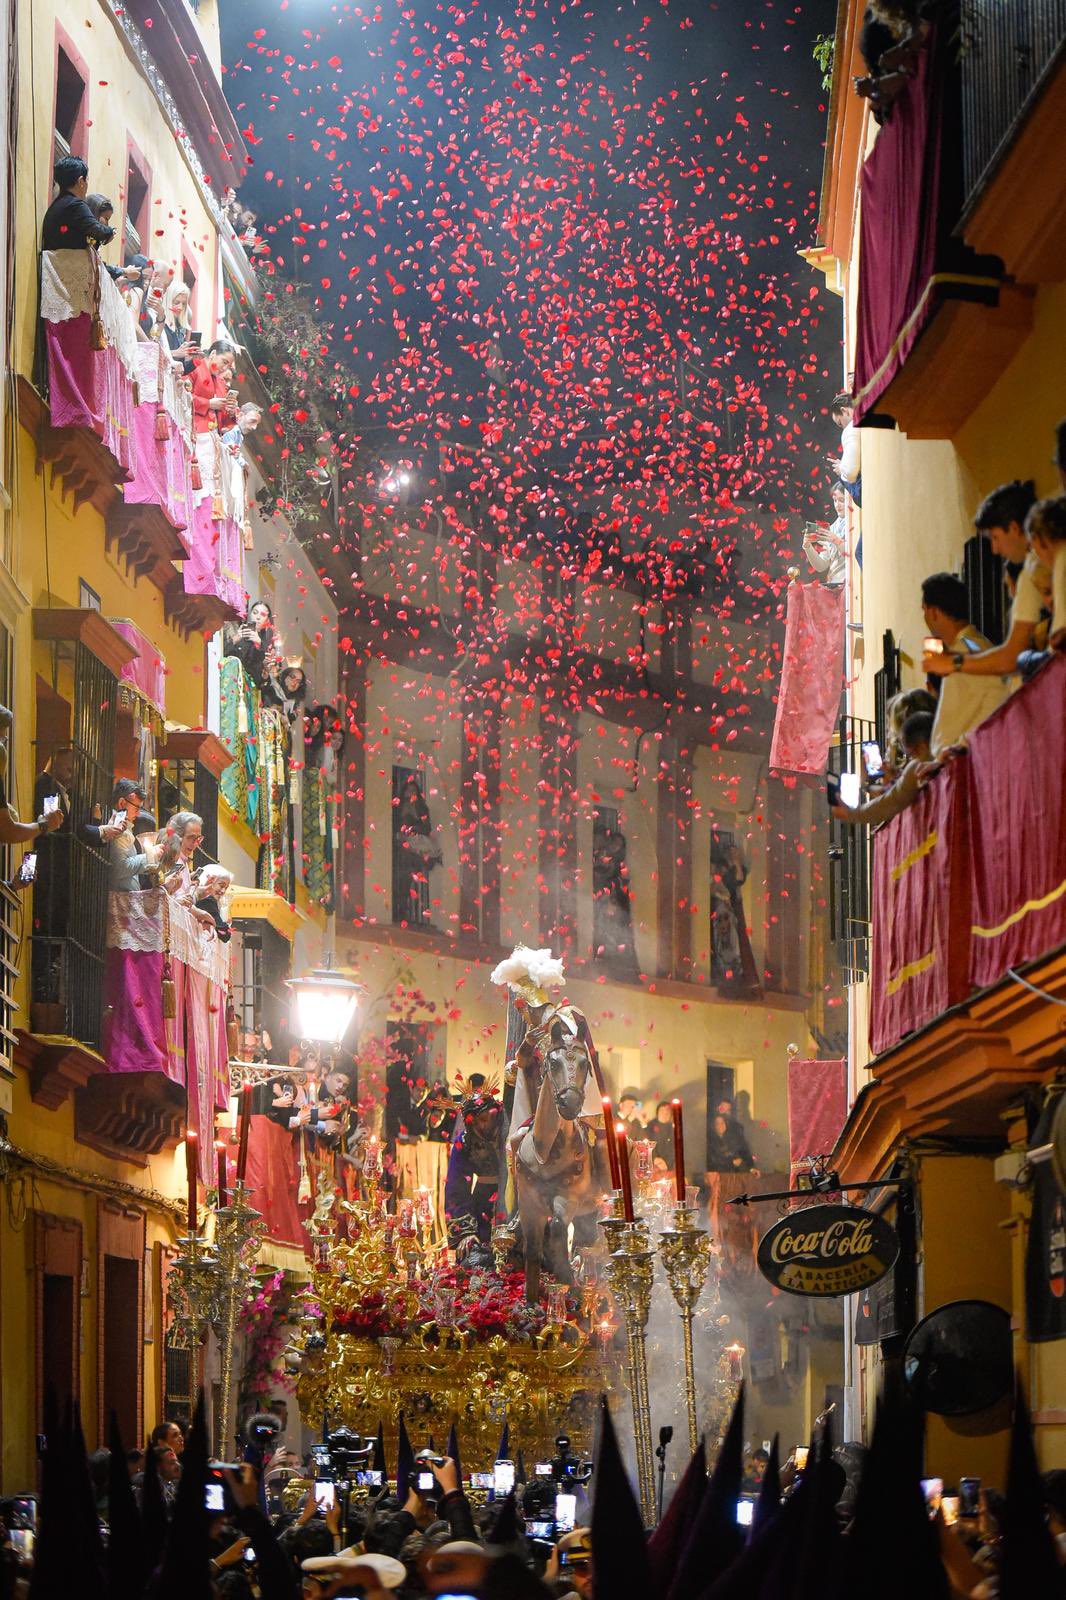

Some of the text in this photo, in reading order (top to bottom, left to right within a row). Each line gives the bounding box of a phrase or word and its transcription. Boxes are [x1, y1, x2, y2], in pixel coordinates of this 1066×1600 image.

[771, 1218, 873, 1263] Coca-Cola
[787, 1268, 877, 1291] LA ANTIGUA
